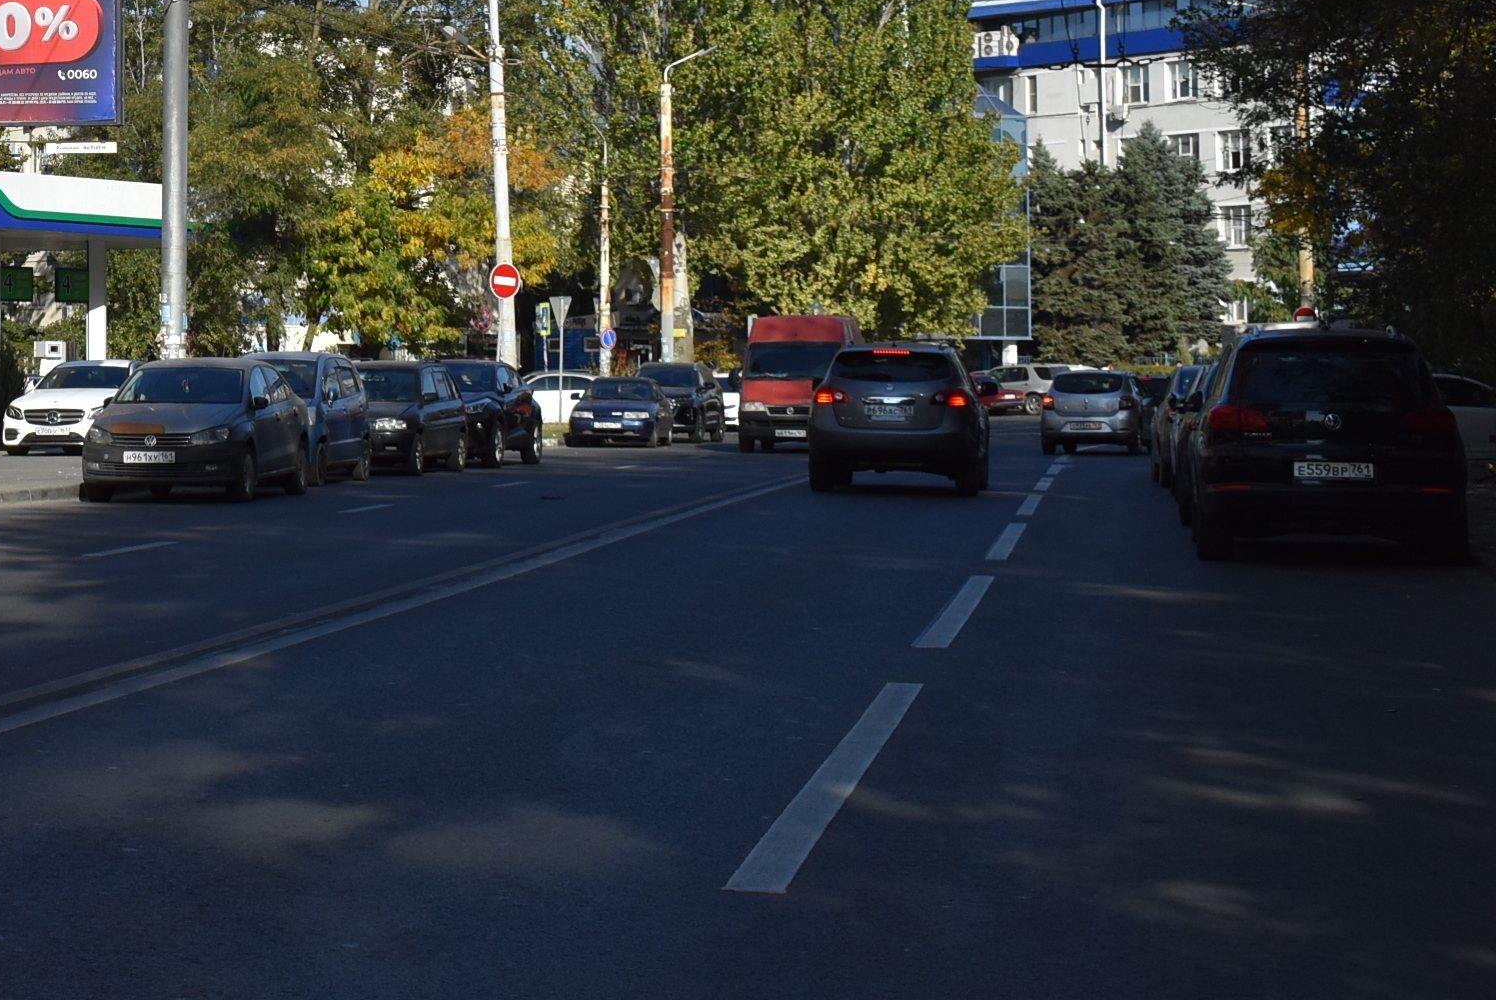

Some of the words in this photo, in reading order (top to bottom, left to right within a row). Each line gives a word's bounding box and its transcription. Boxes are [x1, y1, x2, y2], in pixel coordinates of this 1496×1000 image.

[15, 67, 36, 76] АВТО
[67, 69, 98, 80] 0060
[126, 452, 158, 462] Н961ХУ
[1297, 463, 1348, 476] Е559ВР
[1350, 463, 1370, 474] 761
